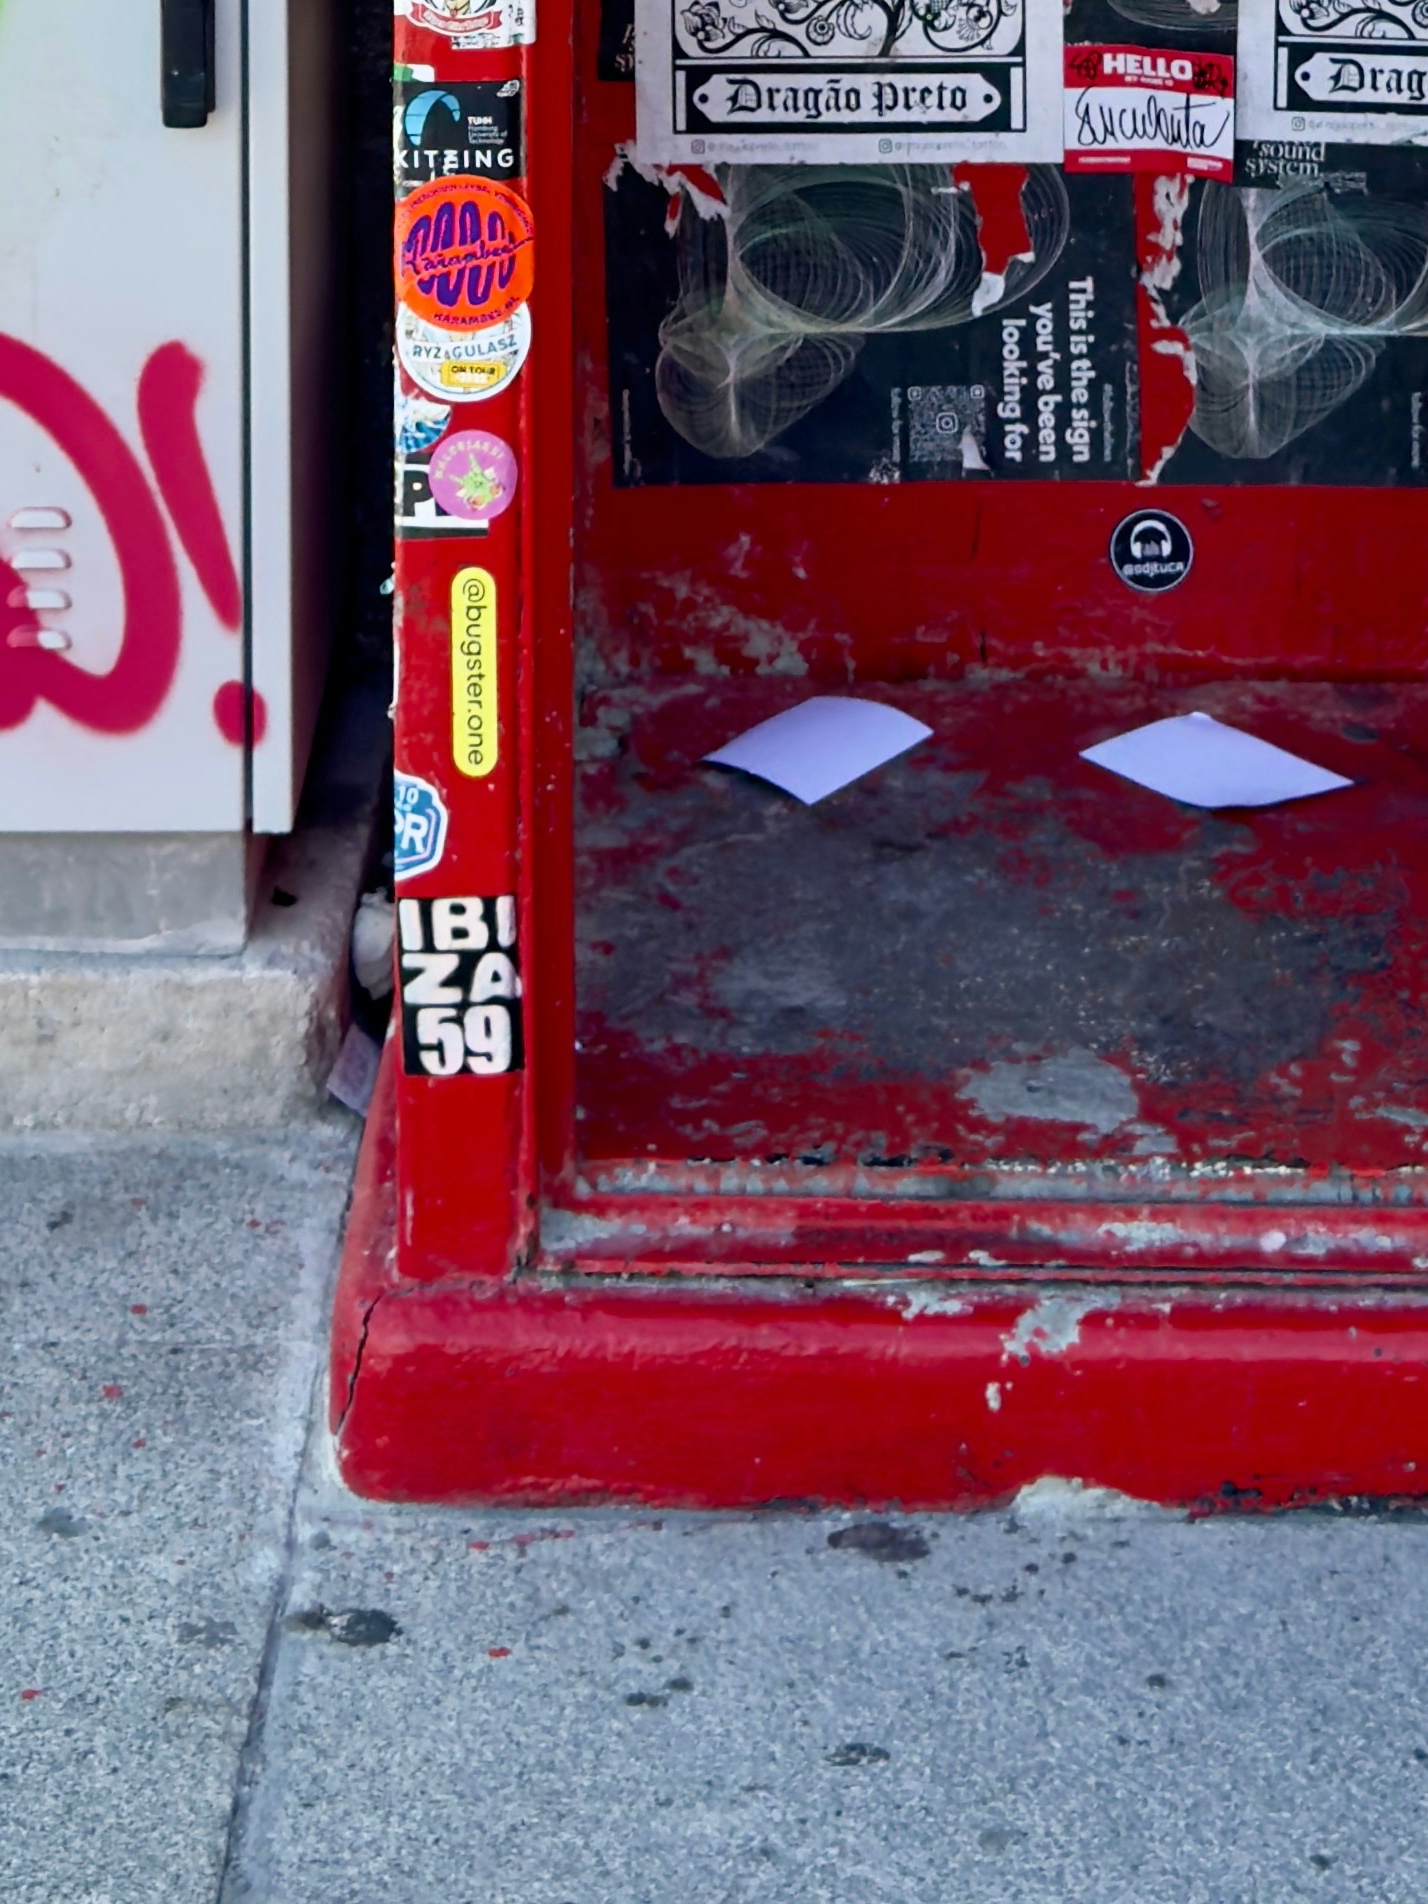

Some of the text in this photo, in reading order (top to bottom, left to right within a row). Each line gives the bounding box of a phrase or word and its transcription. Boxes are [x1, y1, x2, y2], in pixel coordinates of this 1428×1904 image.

[1102, 52, 1194, 80] HELLO
[725, 77, 861, 121] Dragão
[1258, 141, 1326, 161] sound
[996, 318, 1030, 463] looking for
[1028, 301, 1064, 463] you've been
[1064, 276, 1097, 463] This is the sign
[461, 576, 486, 768] @bugster.one
[398, 894, 517, 952] IBI
[401, 951, 522, 1005] ZA
[416, 1003, 514, 1076] 59
